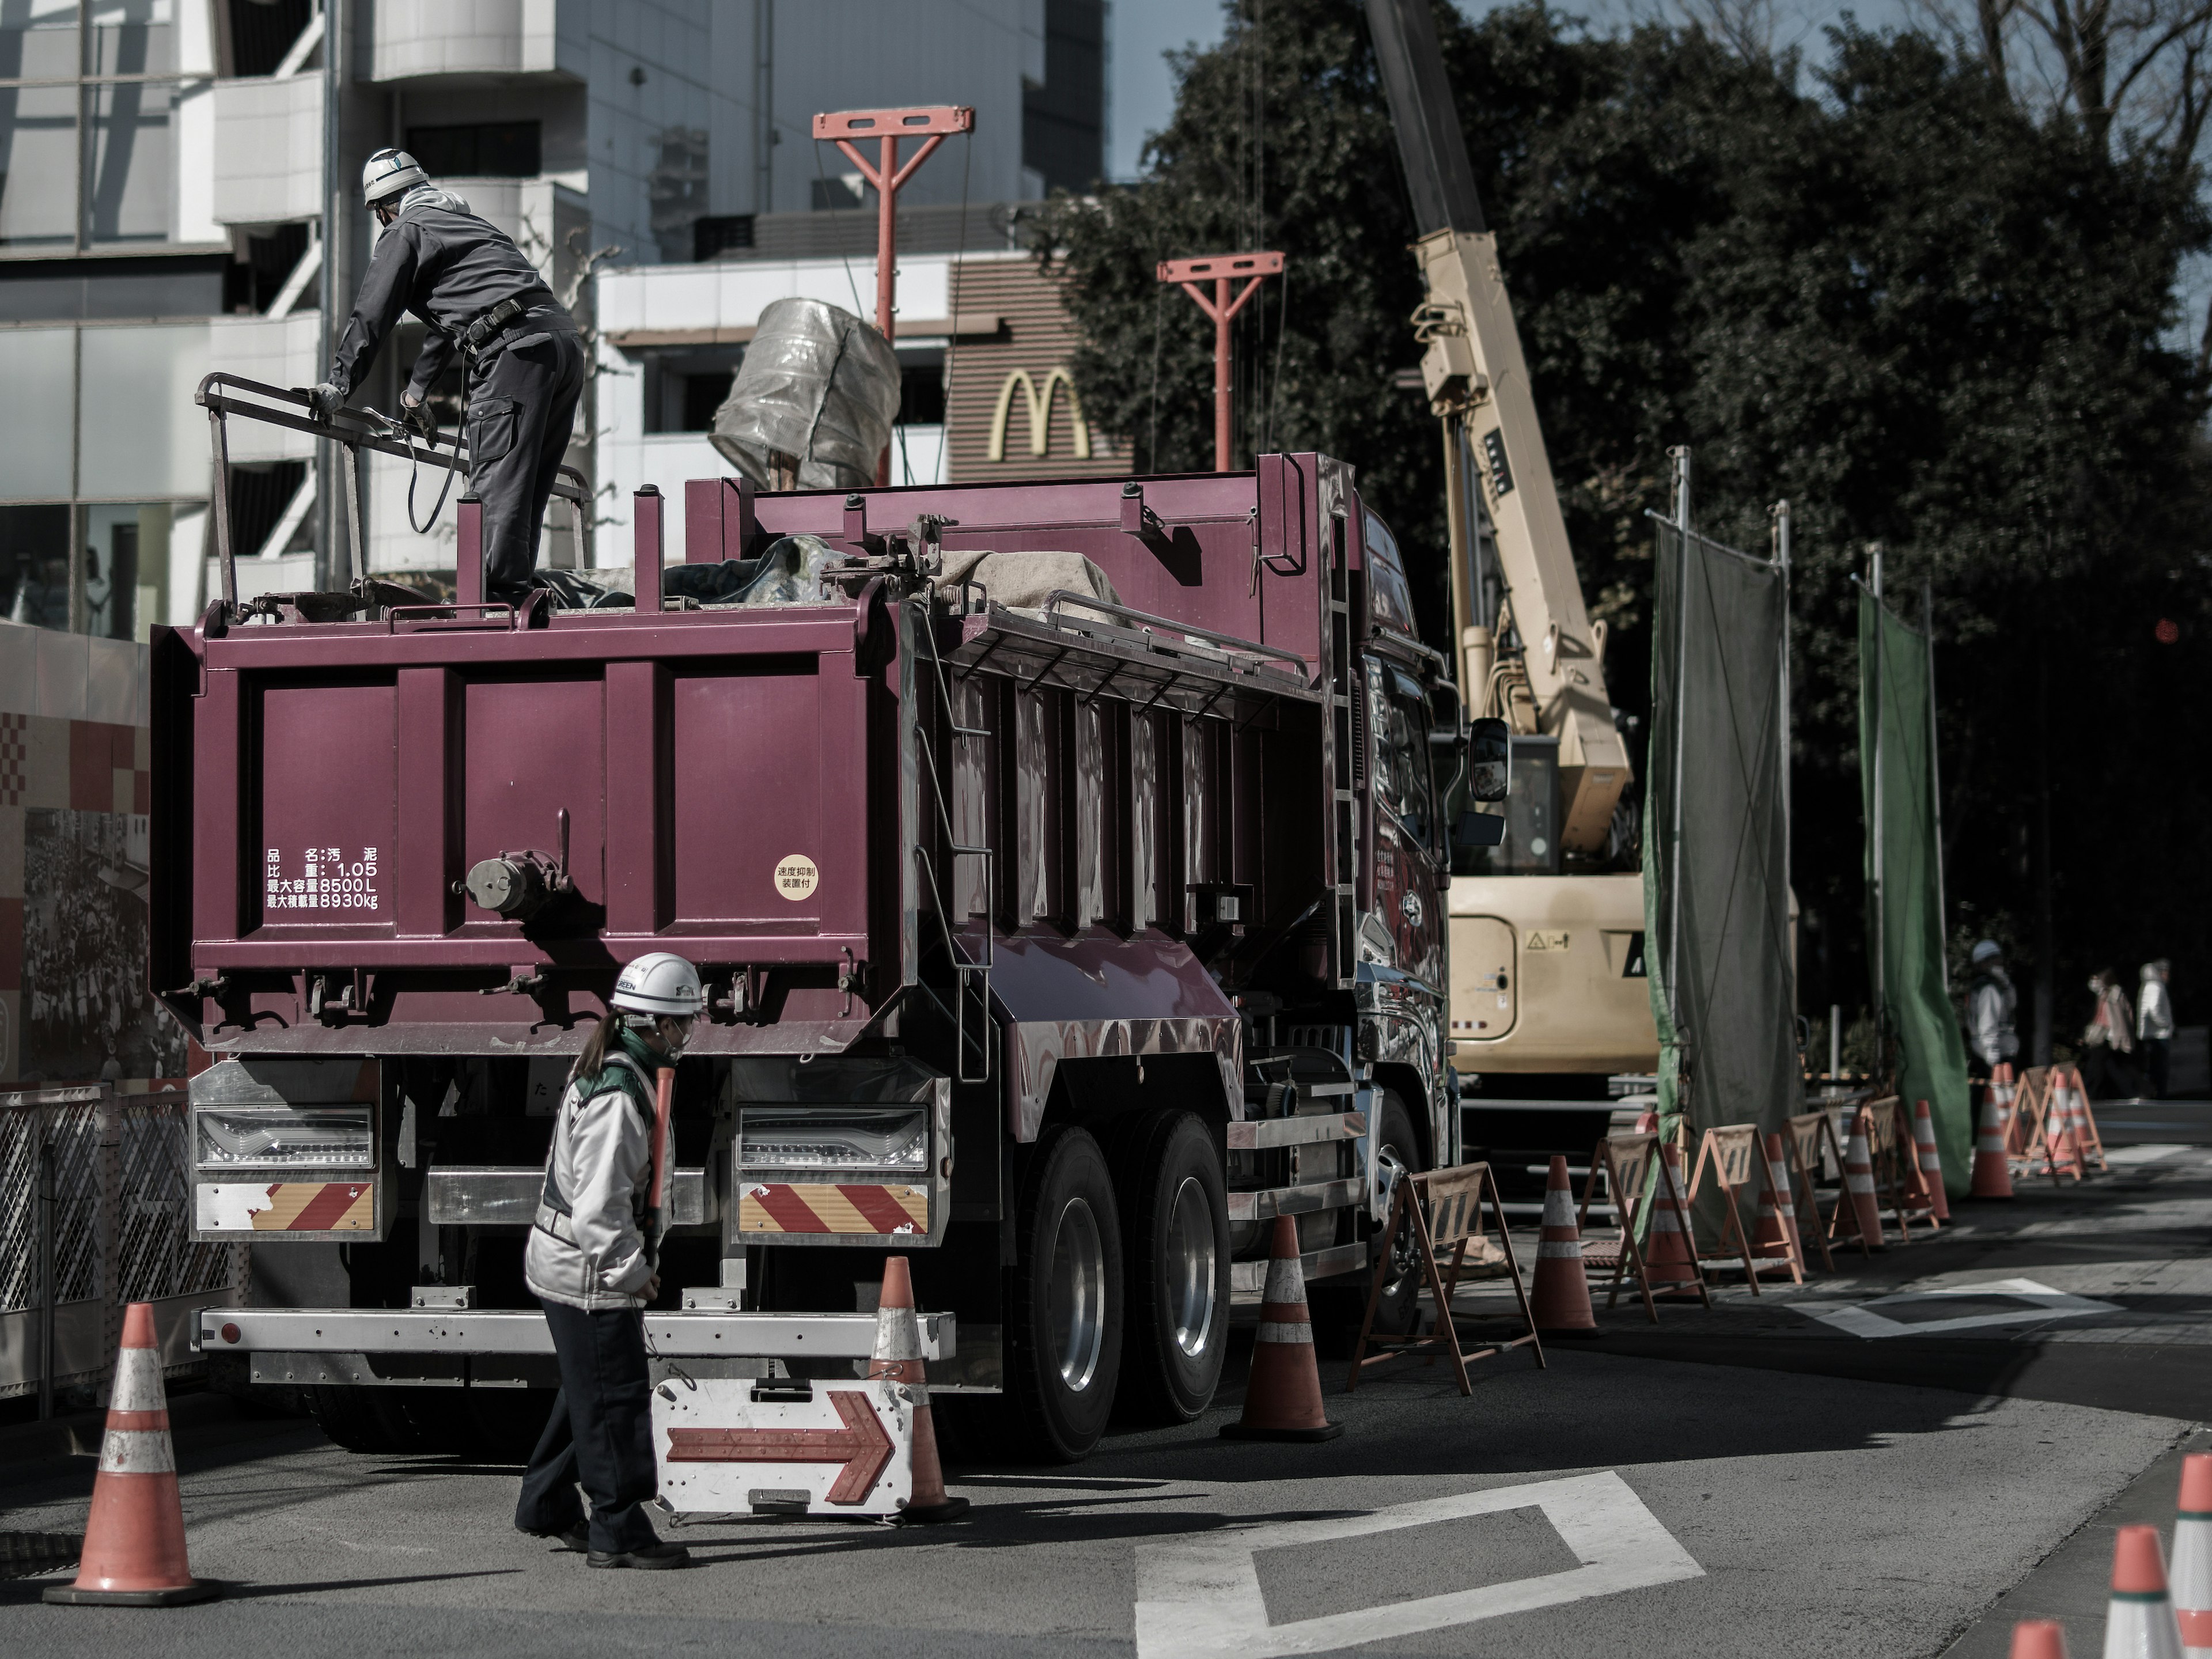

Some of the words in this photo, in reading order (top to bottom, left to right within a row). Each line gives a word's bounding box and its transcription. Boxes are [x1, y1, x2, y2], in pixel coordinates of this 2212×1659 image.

[778, 866, 816, 876] 速度抑制
[782, 878, 810, 888] 装置付
